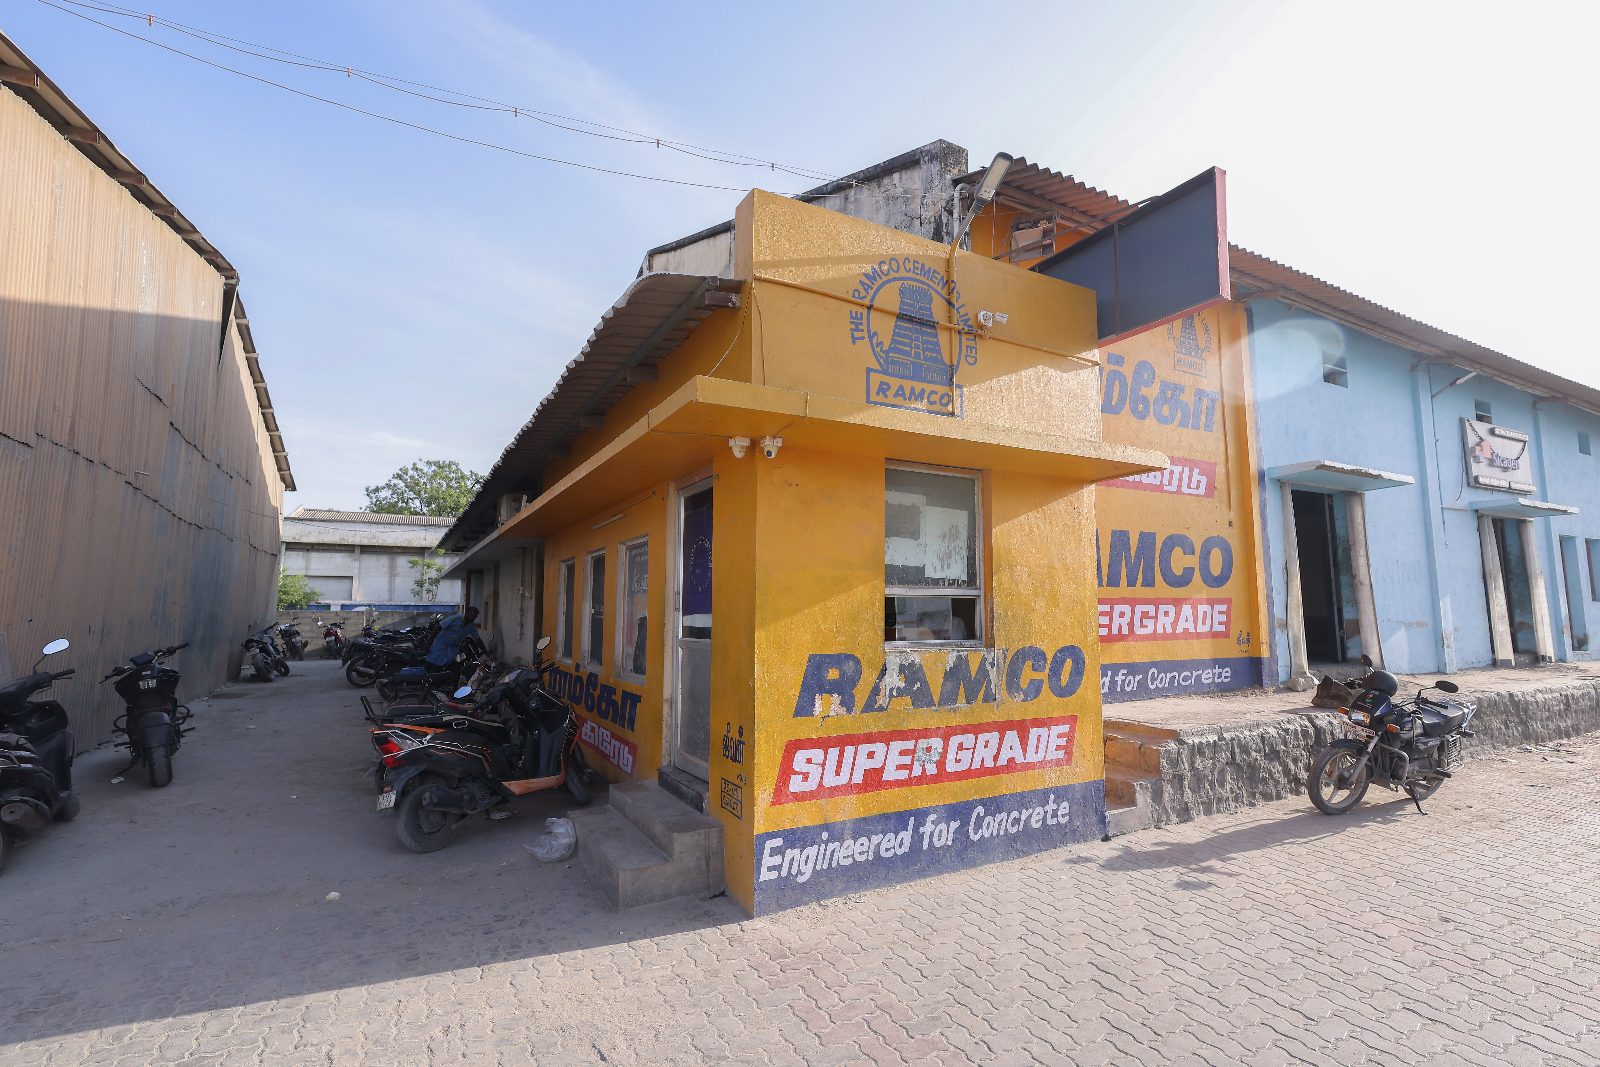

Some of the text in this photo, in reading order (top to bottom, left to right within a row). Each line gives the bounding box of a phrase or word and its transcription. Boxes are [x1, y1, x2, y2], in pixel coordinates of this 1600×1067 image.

[852, 257, 901, 301] RAMCO
[849, 309, 865, 346] THE
[876, 381, 951, 406] RAMCO
[1099, 352, 1221, 433] ம்கோ
[793, 644, 1086, 718] RAMCO
[1115, 669, 1143, 692] for
[1148, 665, 1232, 690] Concrete
[758, 794, 1071, 884] Engineered for Concrete
